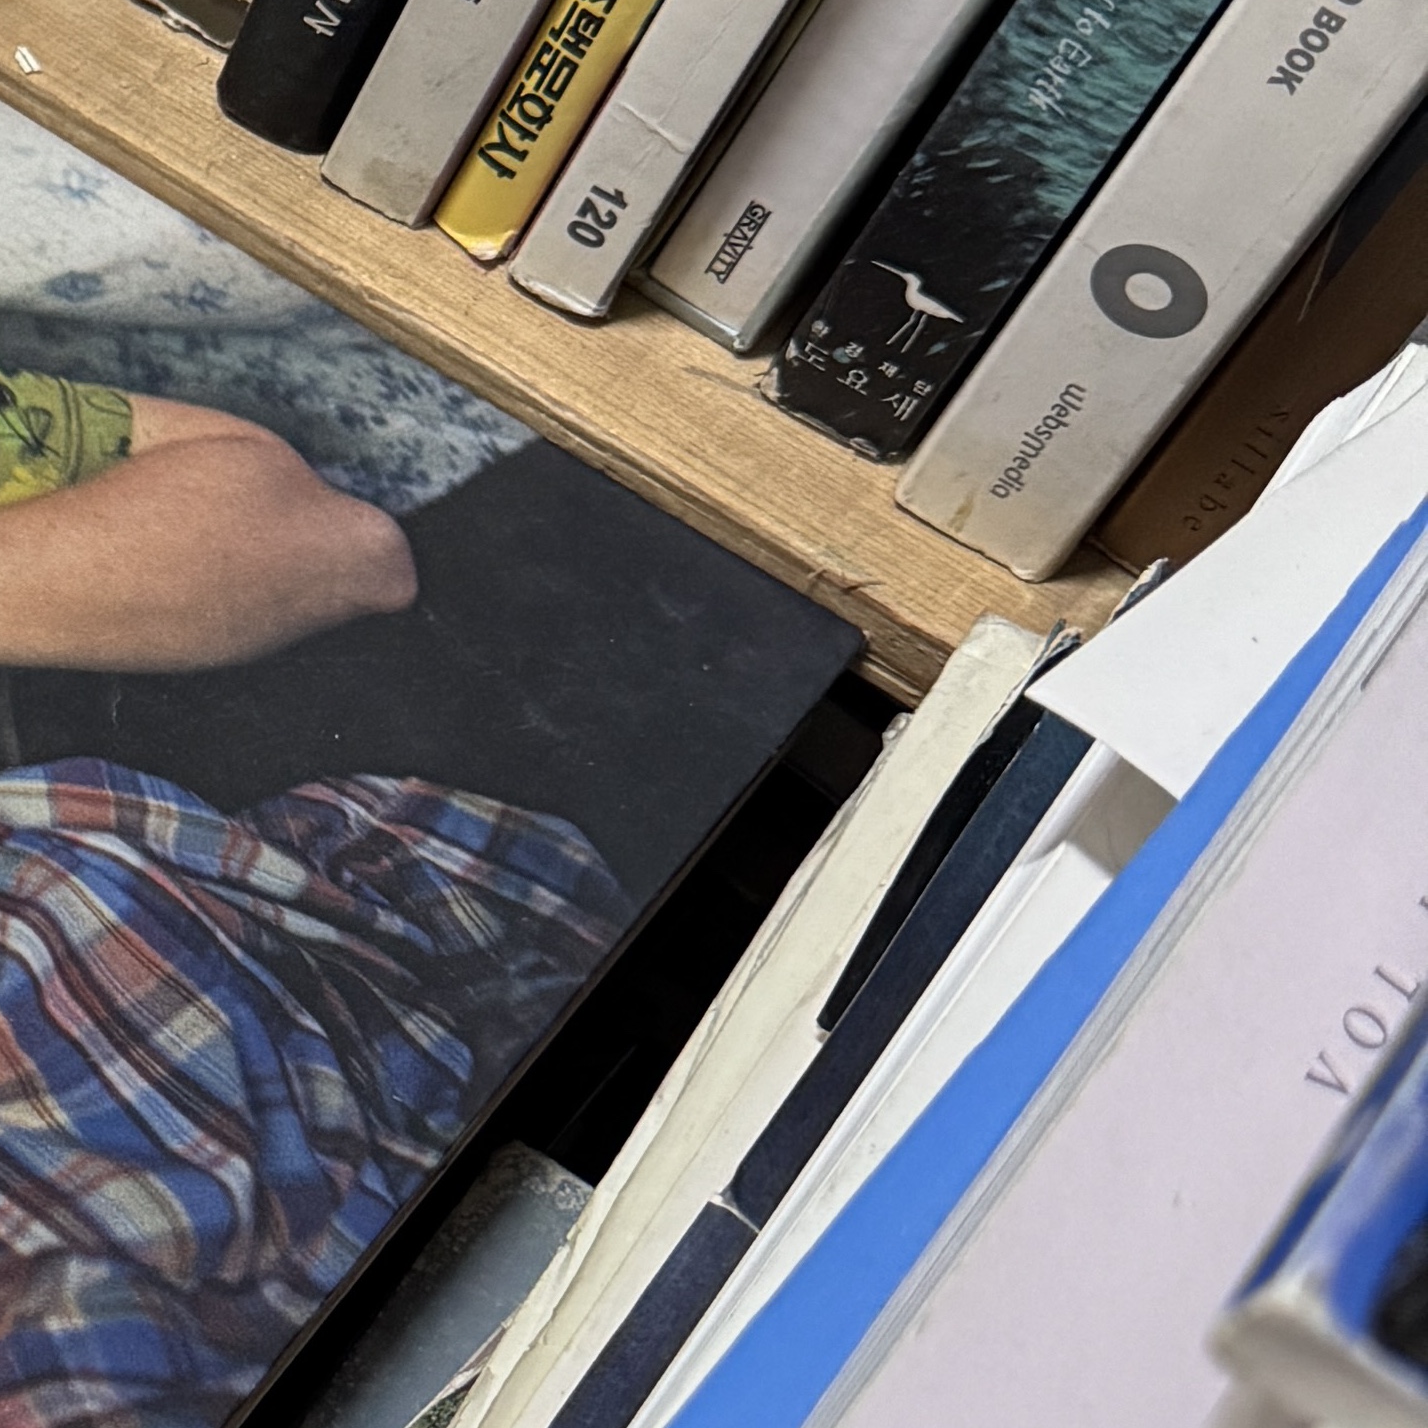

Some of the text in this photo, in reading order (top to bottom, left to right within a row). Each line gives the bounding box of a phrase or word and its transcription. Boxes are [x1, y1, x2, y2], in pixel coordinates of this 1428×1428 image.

[1075, 5, 1110, 37] to
[1266, 7, 1349, 96] BOOK
[1029, 35, 1092, 115] Earth
[566, 185, 630, 250] 120
[706, 200, 773, 284] GRAVITY
[1183, 408, 1289, 533] sillabe
